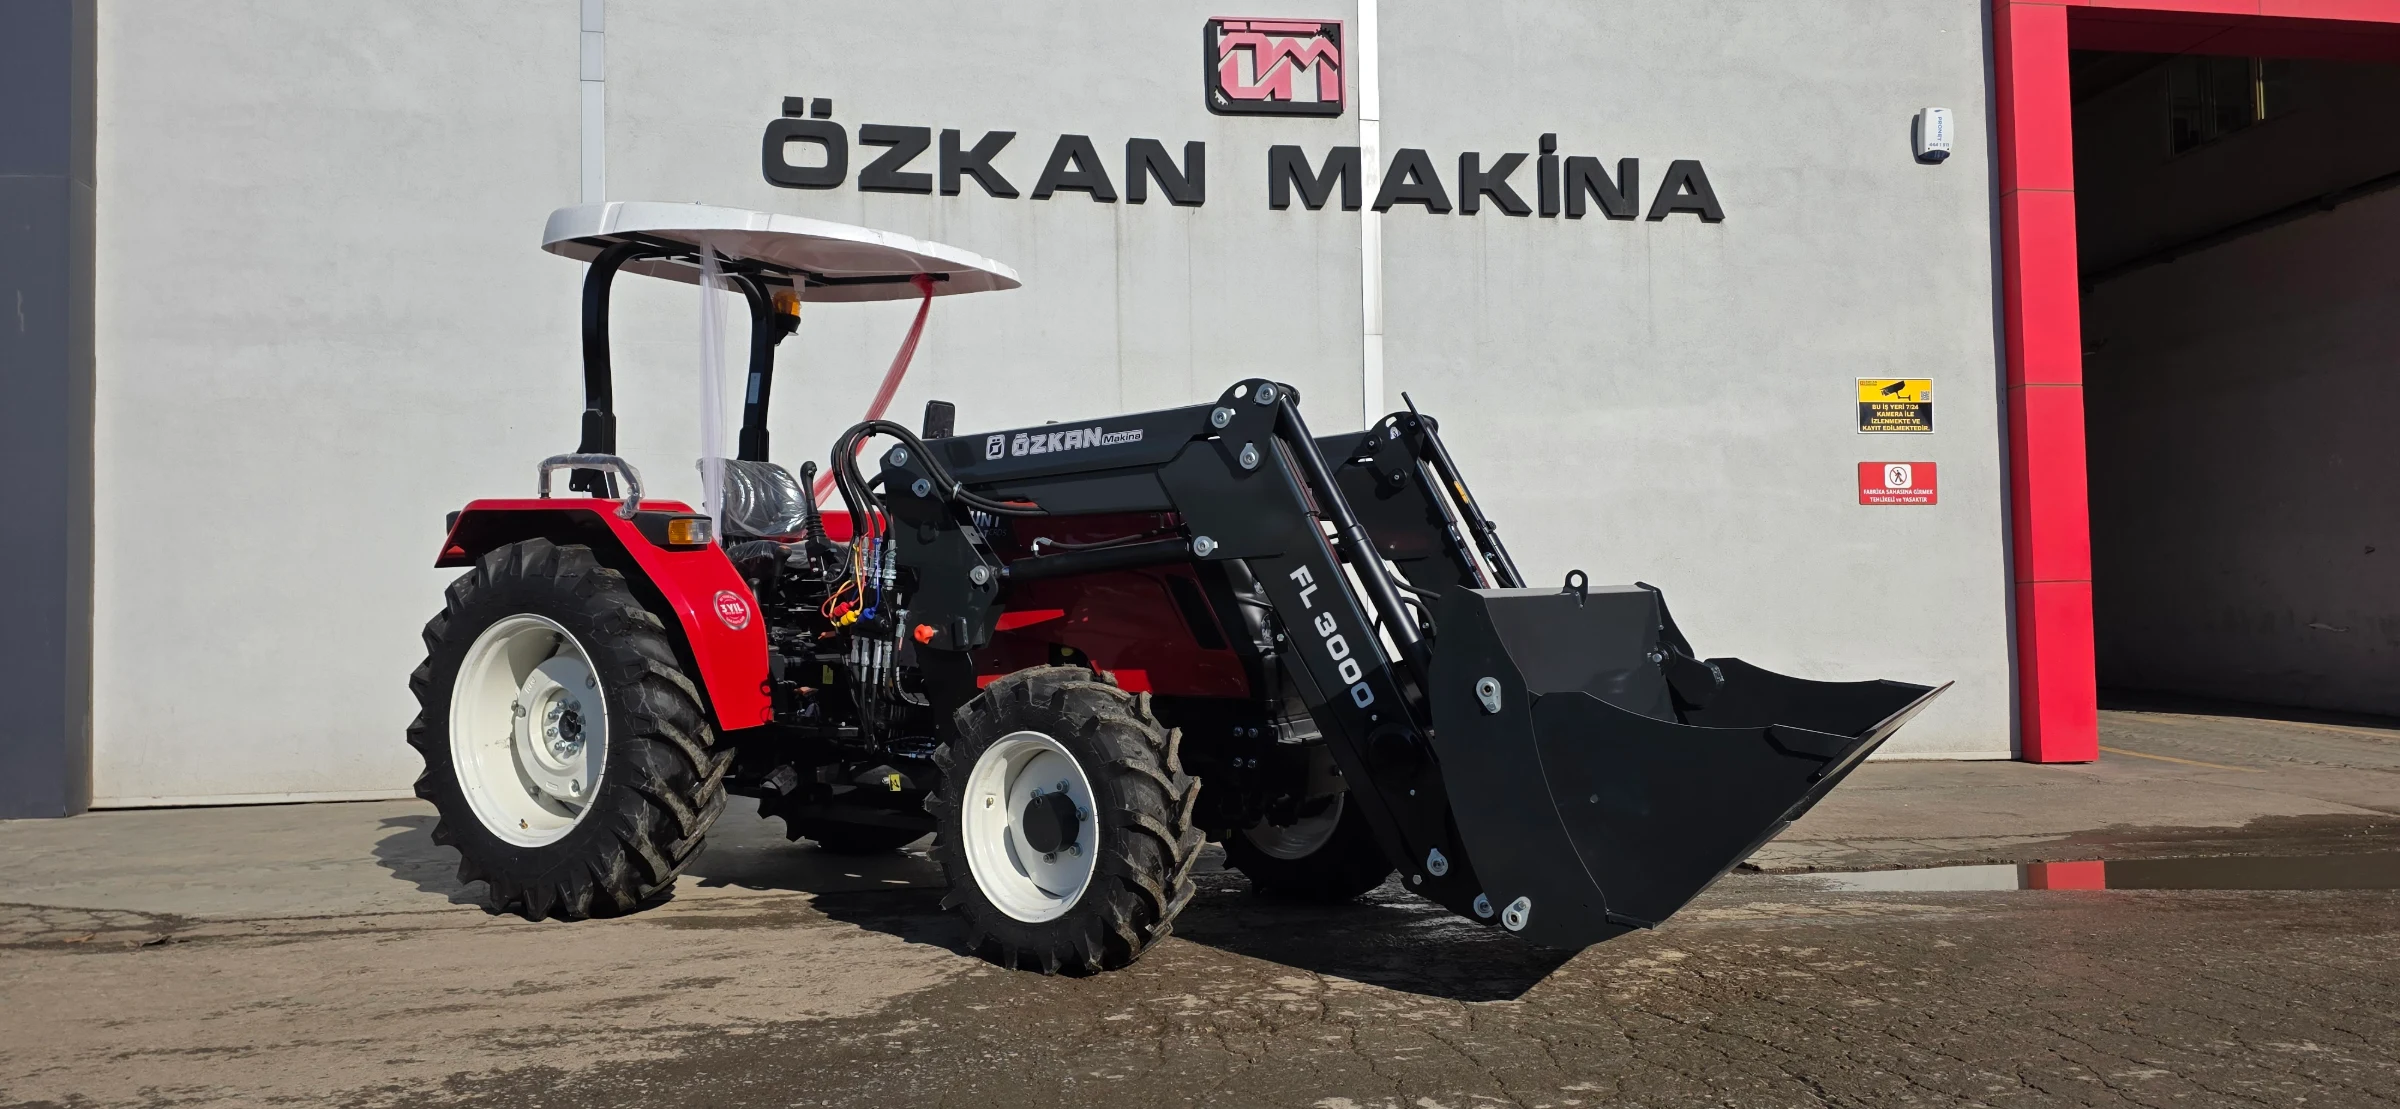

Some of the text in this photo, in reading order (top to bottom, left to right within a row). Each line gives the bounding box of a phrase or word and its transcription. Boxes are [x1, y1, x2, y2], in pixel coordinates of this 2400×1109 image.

[762, 96, 1726, 223] ÖZKAN MAKİNA
[1012, 427, 1102, 457] ÖZKAN
[1103, 430, 1142, 445] Makina
[720, 603, 744, 612] 3 YIL
[1289, 564, 1374, 708] FL 3000
